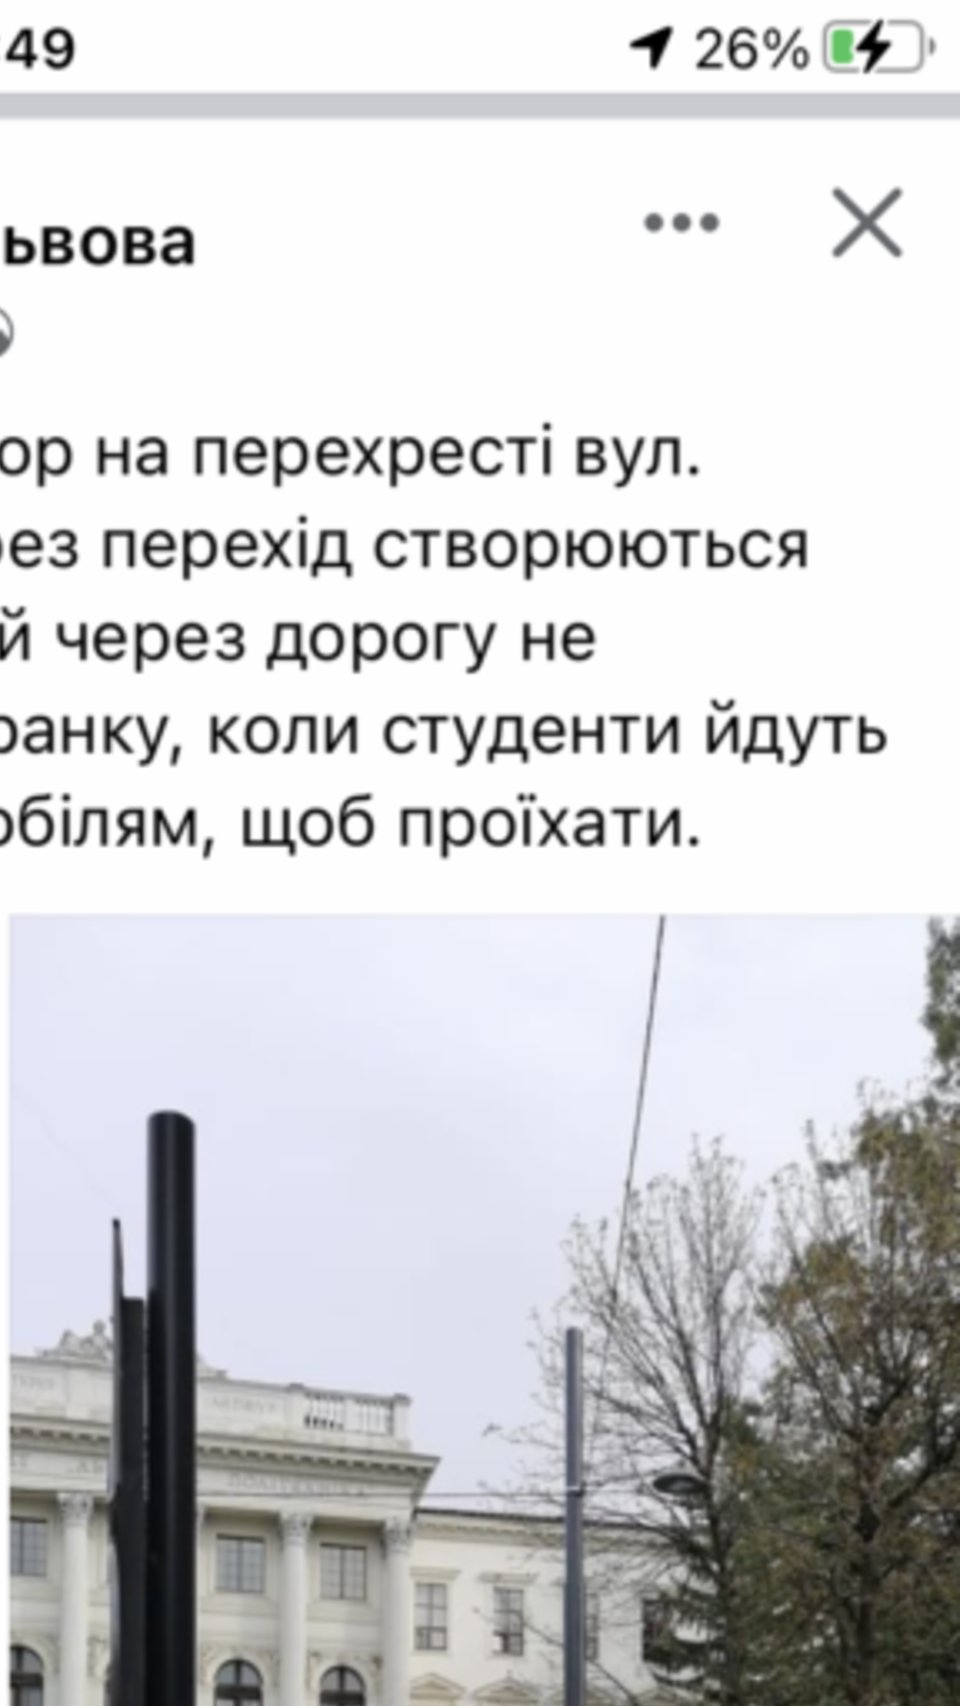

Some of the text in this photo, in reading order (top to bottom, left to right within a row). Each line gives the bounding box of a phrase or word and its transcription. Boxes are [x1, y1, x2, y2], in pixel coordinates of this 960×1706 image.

[696, 27, 810, 70] 26%
[97, 436, 168, 476] на
[195, 422, 551, 488] перехресті
[576, 436, 699, 488] вул.
[103, 515, 353, 580] перехід
[374, 529, 807, 581] створюються
[56, 622, 245, 673] через
[266, 622, 497, 674] дорогу
[523, 622, 596, 662] не
[210, 715, 357, 754] коли
[383, 715, 679, 767] студенти
[706, 699, 887, 767] йдуть
[243, 793, 374, 856] щоб
[400, 793, 699, 859] проїхати.
